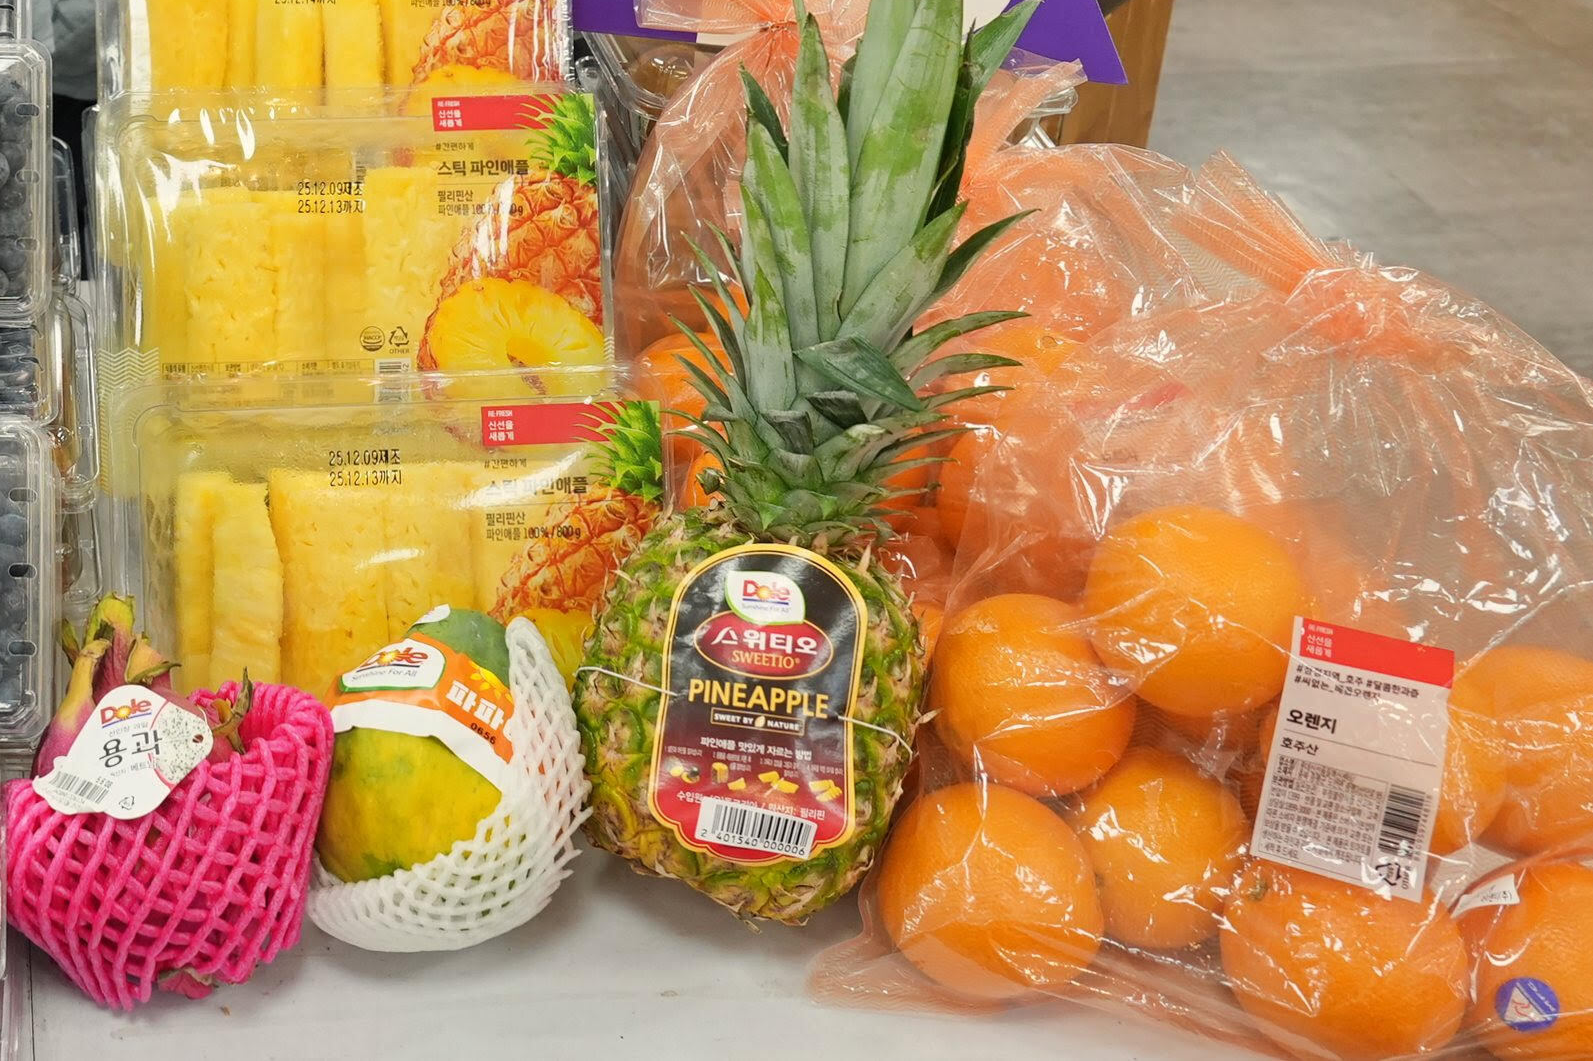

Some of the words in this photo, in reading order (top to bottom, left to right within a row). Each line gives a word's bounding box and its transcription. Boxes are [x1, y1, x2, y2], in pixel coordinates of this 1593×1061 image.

[435, 142, 474, 151] #간편하게
[437, 160, 466, 176] 스틱
[470, 159, 529, 176] 파인애플
[437, 190, 473, 202] 필리핀산
[298, 199, 364, 214] 25.12.13까지
[438, 204, 469, 216] 파인애플
[488, 420, 514, 430] 신선을
[489, 432, 515, 441] 새롭게
[329, 449, 401, 466] 25.12.09제조
[484, 458, 527, 469] #간편하게
[329, 470, 402, 487] 25.12.13까지
[486, 512, 525, 526] 필리핀산
[486, 528, 521, 541] 파인애플
[524, 526, 548, 539] 100%
[743, 580, 790, 601] Dole
[711, 626, 817, 655] 스위티오
[361, 646, 429, 667] Dole
[387, 667, 405, 676] For
[404, 668, 418, 677] All
[689, 678, 829, 719] PINEAPPLE
[100, 698, 152, 725] Dole
[714, 713, 741, 723] SWEET
[742, 716, 754, 725] BY
[767, 720, 801, 731] NATURE
[1286, 708, 1337, 734] 오렌지
[470, 722, 496, 746] 0656
[99, 729, 163, 769] 용과
[700, 736, 736, 750] 파인애플
[738, 741, 765, 754] 맛있게
[767, 746, 793, 757] 자르는
[795, 750, 812, 761] 방법
[1280, 737, 1319, 756] 호주산
[799, 808, 826, 821] 필리핀
[701, 828, 707, 837] 2
[716, 830, 758, 847] 401540
[763, 840, 806, 856] 000006
